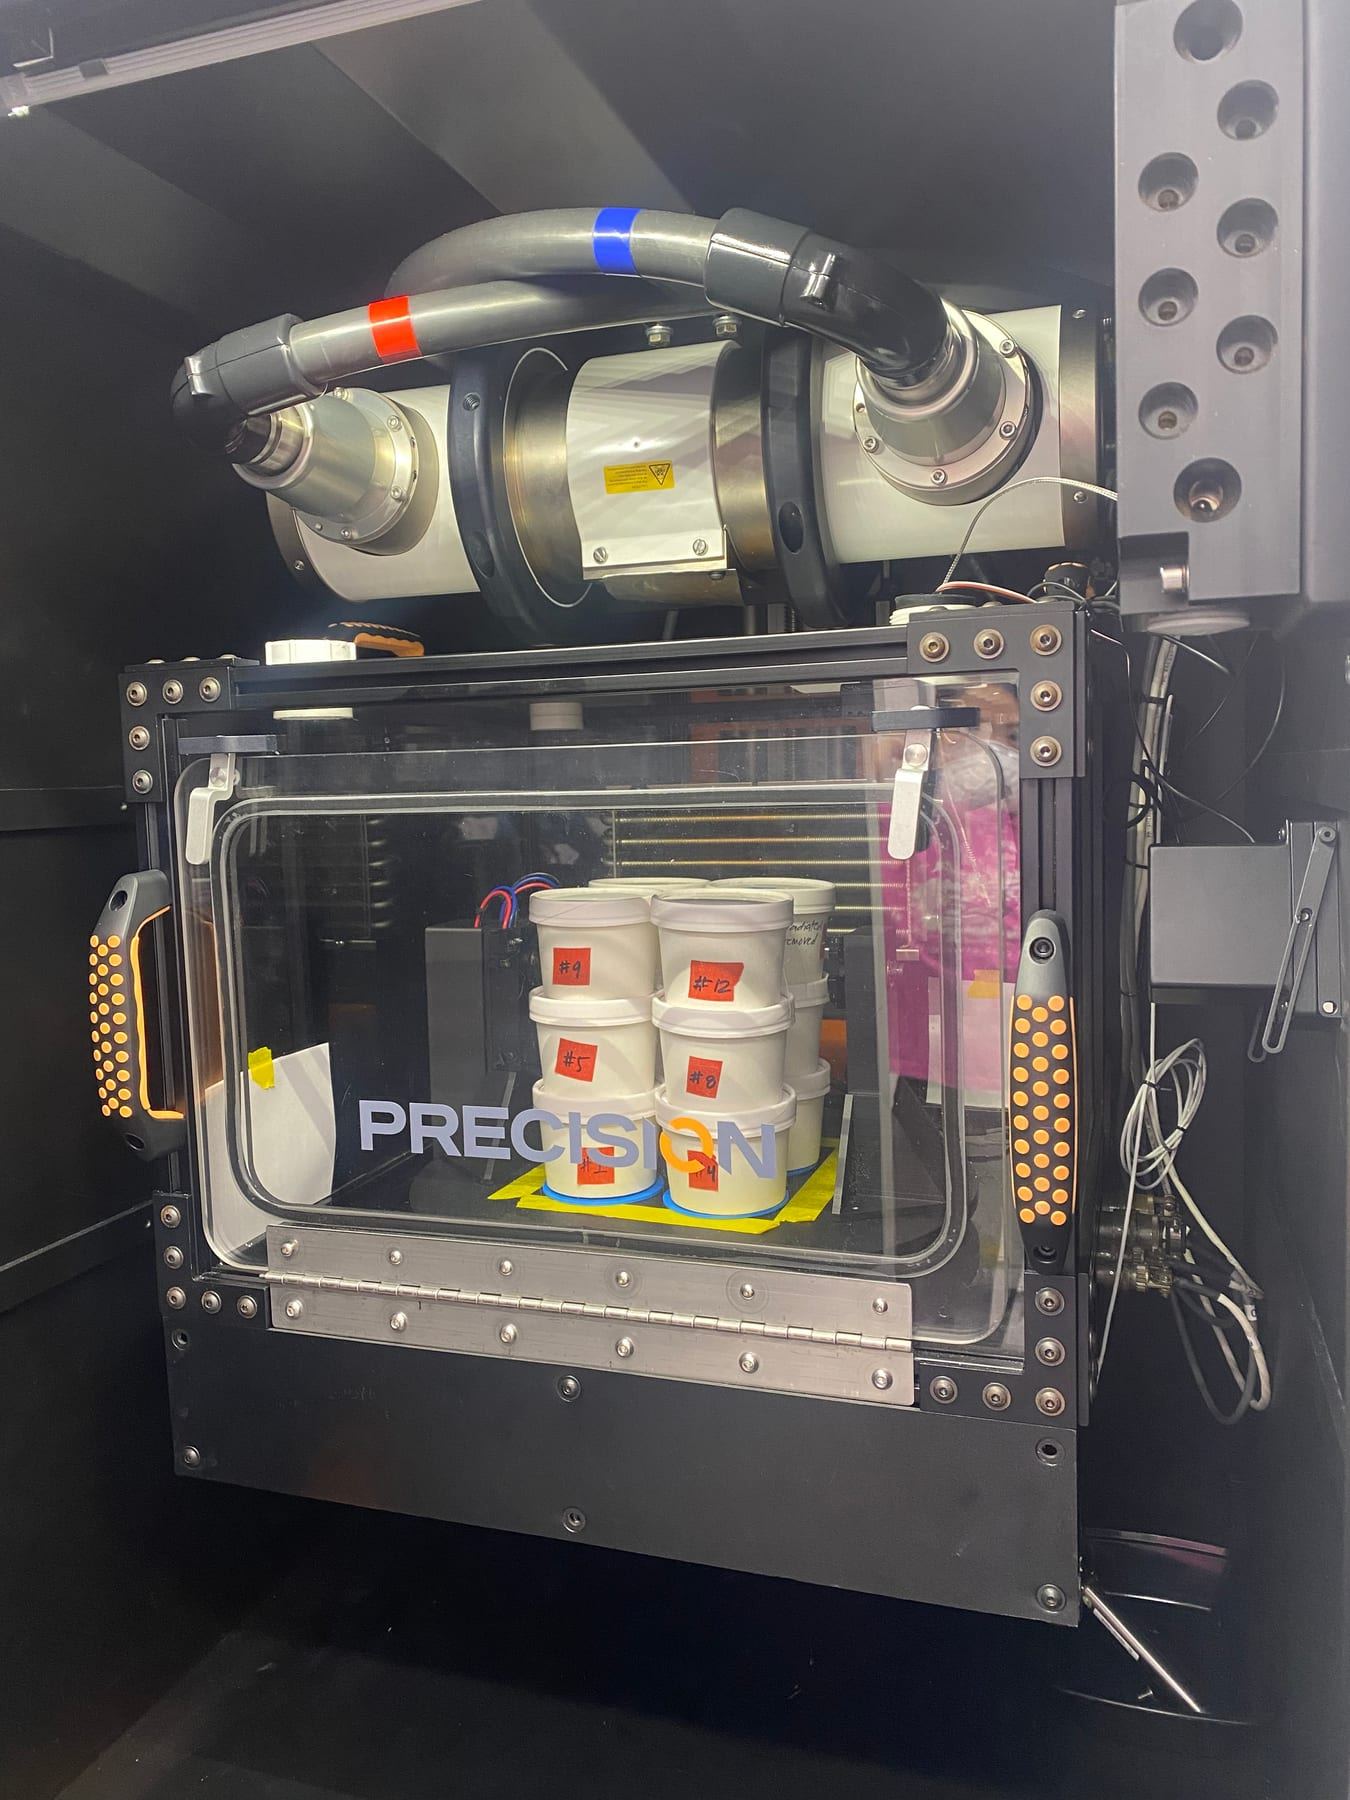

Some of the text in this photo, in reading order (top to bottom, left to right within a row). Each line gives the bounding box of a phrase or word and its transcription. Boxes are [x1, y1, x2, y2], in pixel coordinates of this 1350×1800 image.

[559, 960, 581, 979] #9
[693, 975, 731, 994] #12
[563, 1051, 591, 1073] #5
[689, 1071, 717, 1090] #8
[358, 1099, 777, 1179] PRECISION
